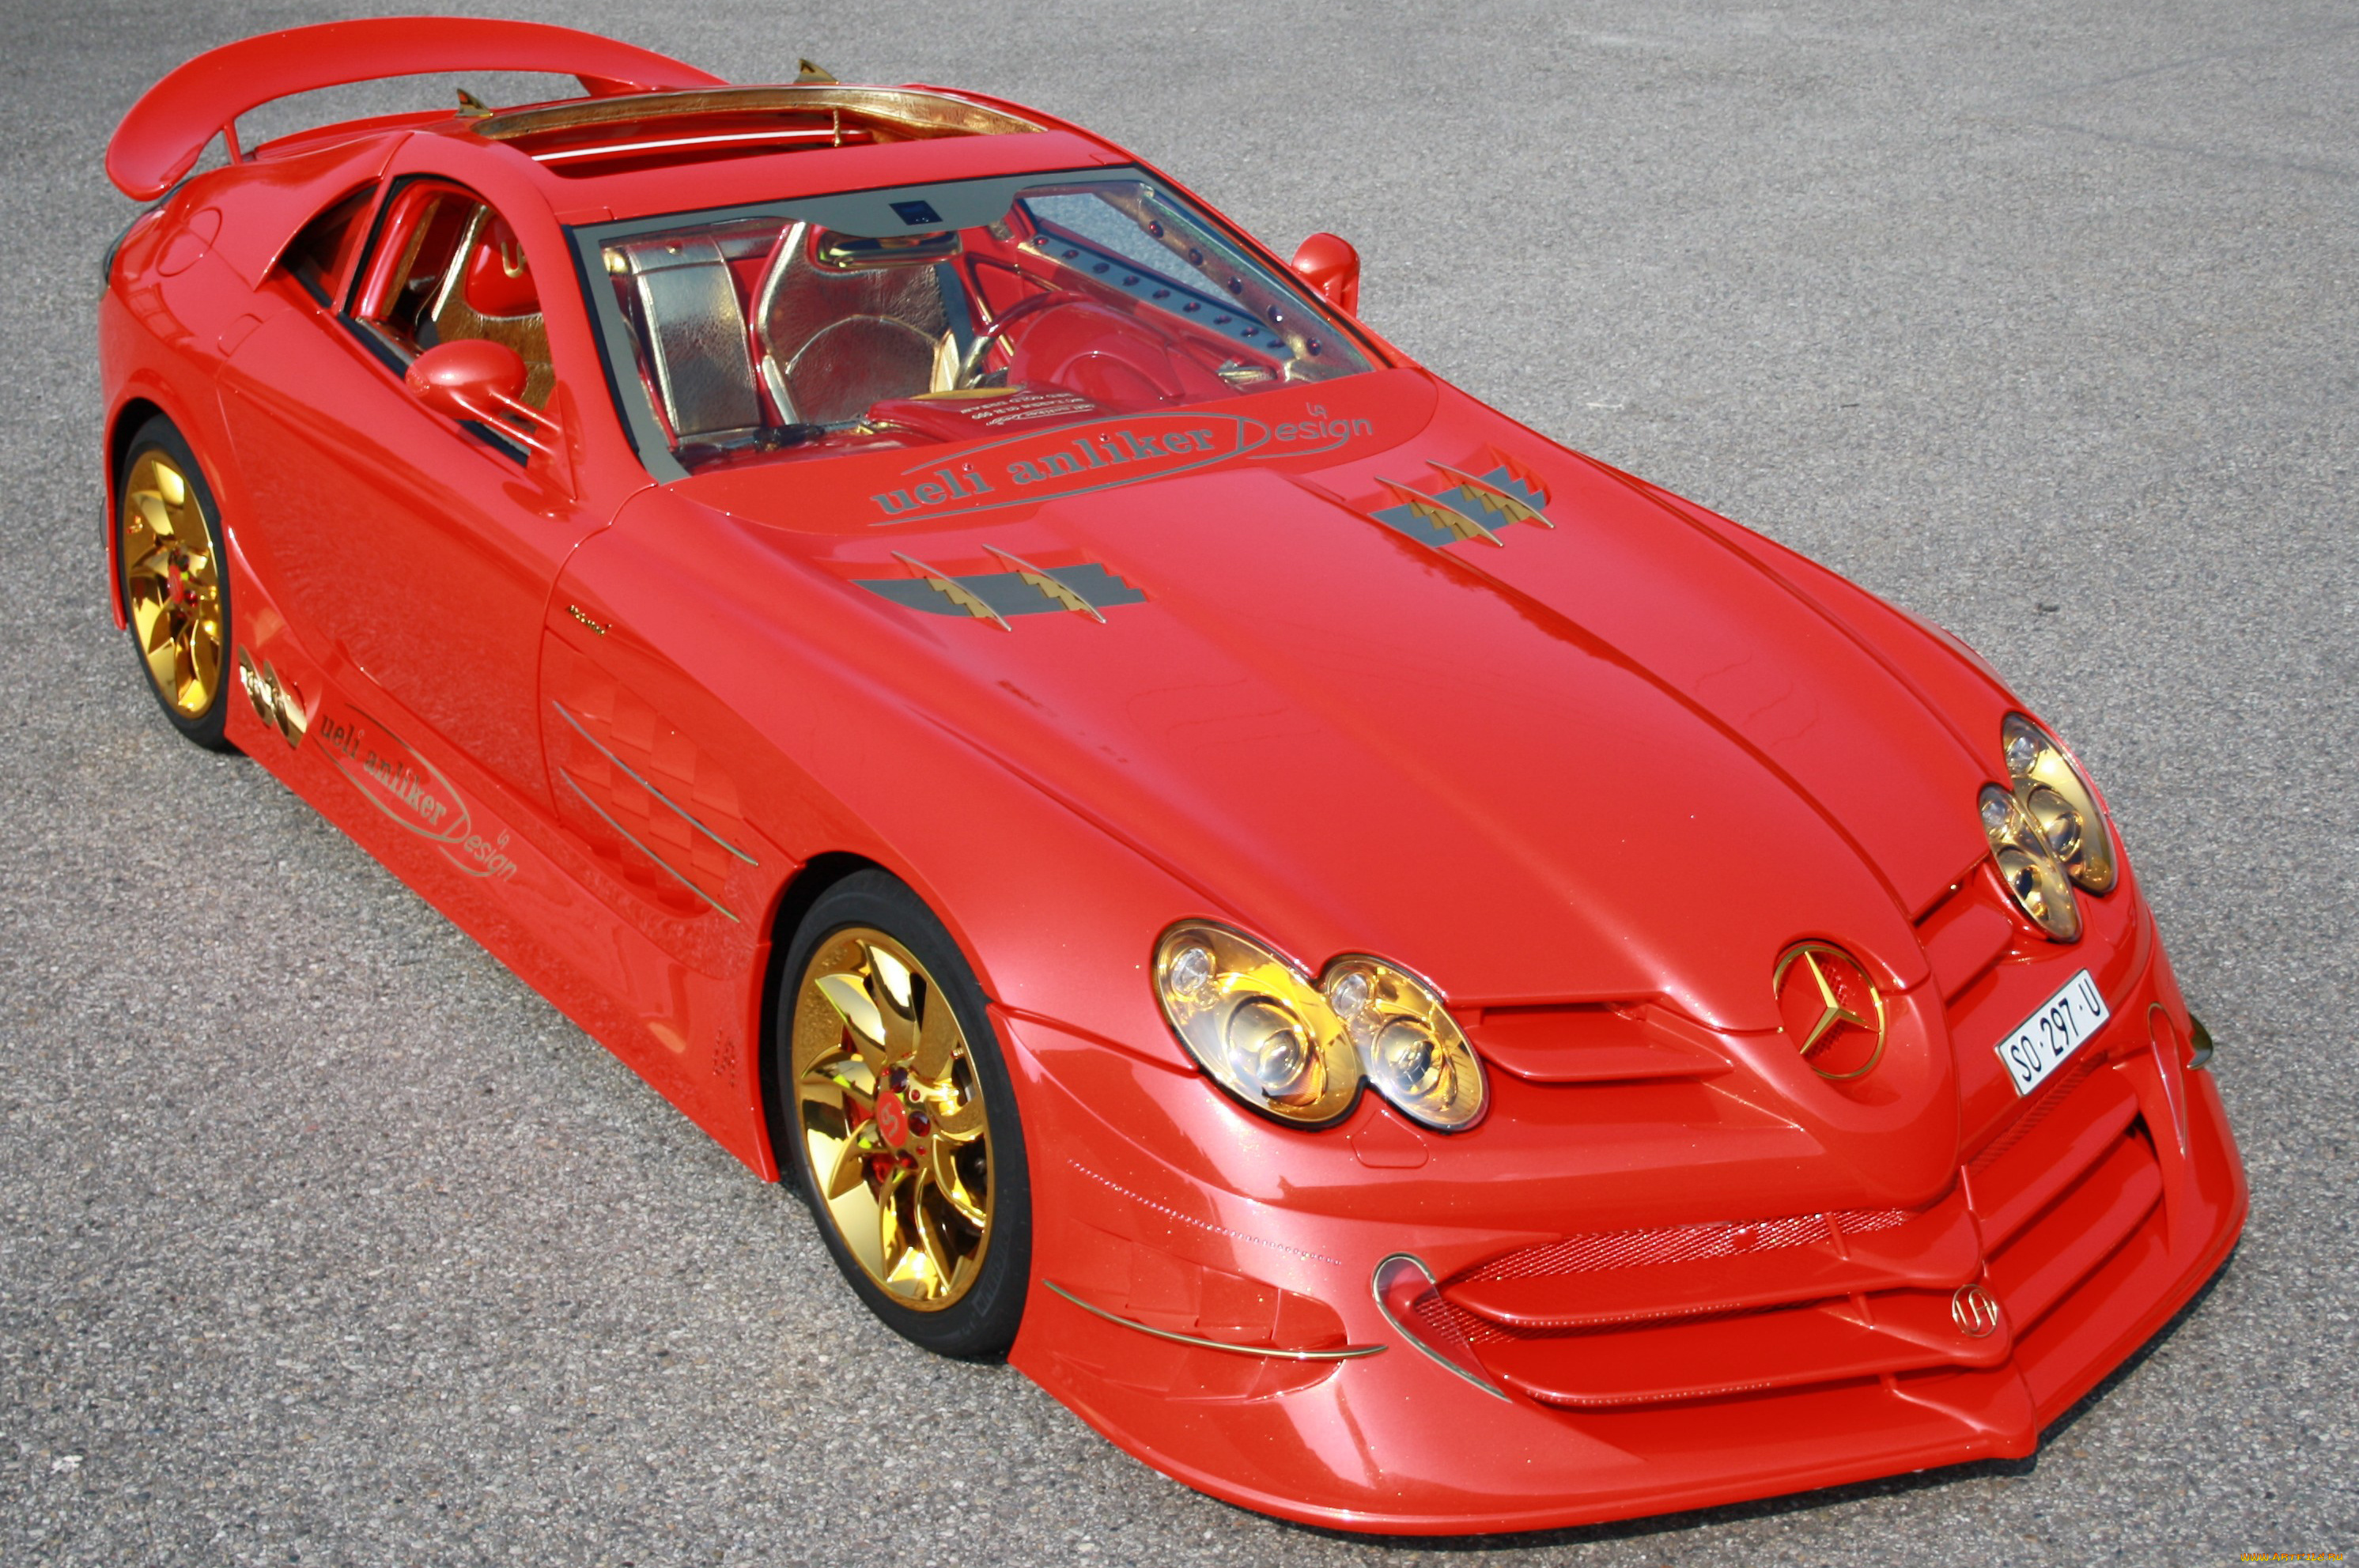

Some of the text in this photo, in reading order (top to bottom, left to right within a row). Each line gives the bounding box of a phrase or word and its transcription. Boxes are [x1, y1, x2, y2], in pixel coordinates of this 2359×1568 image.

[870, 414, 1374, 515] ueli anliker Design
[319, 714, 365, 760] ueli
[363, 750, 448, 826] anliker
